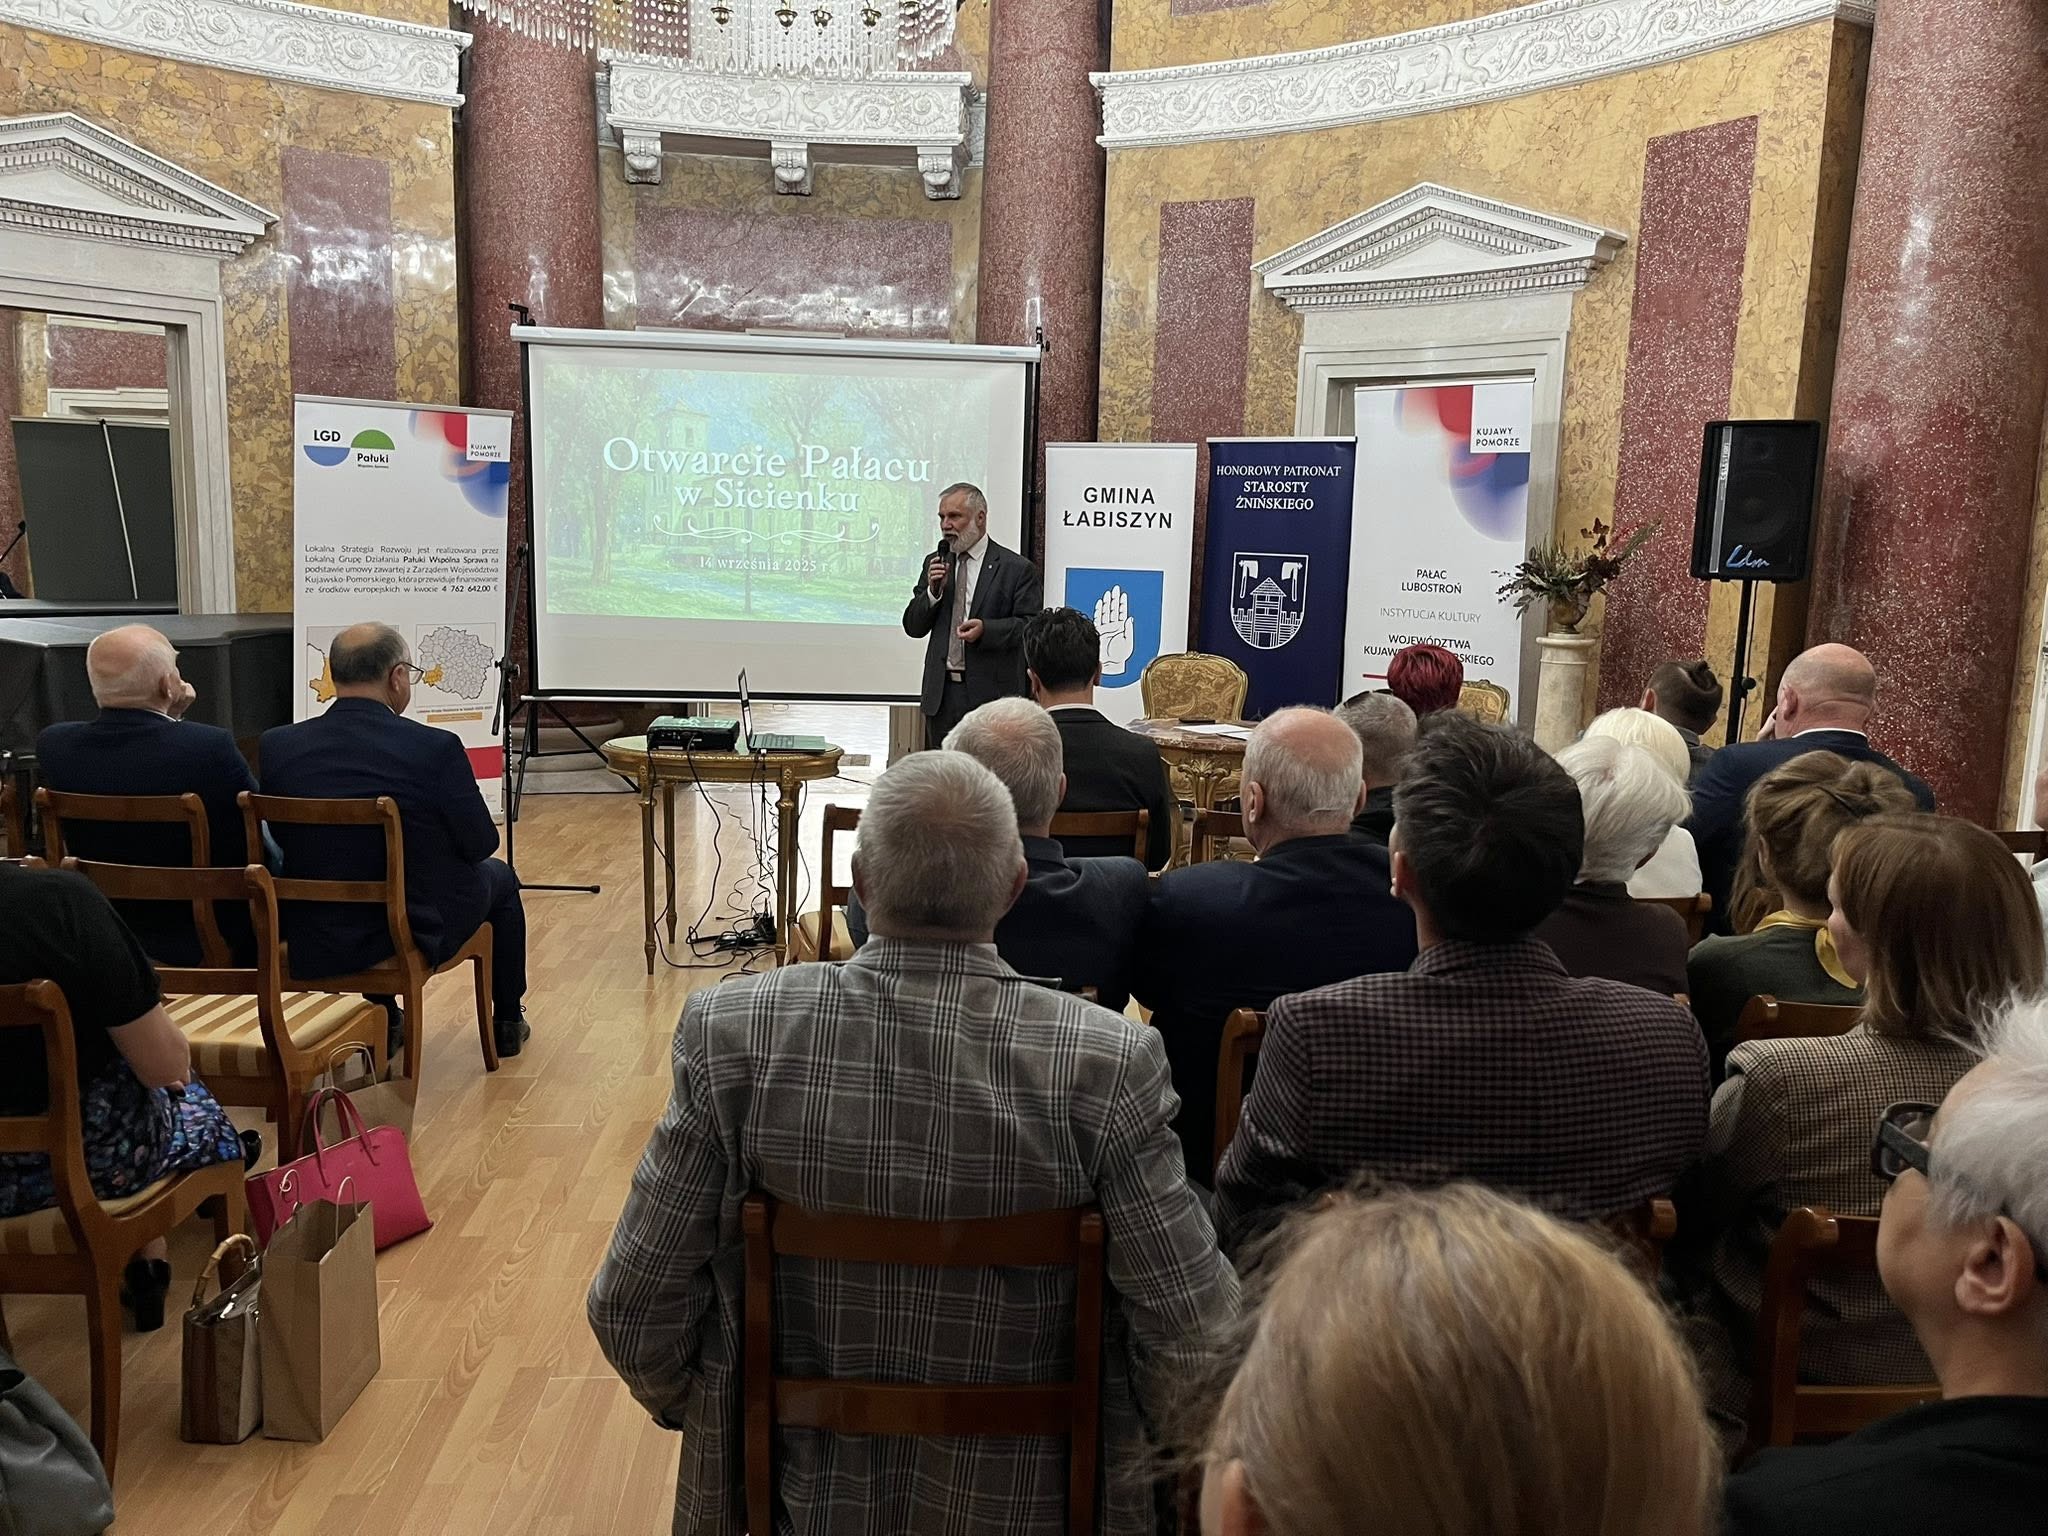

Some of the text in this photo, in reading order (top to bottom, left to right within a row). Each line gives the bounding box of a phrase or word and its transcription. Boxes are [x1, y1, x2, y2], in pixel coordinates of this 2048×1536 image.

[314, 430, 341, 442] LGD
[1476, 427, 1513, 436] KUJAWY
[1475, 437, 1520, 447] POMORZE
[357, 453, 389, 463] Pałuki
[602, 437, 931, 483] Otwarcie Pałacu
[1216, 465, 1342, 477] HONOROWY PATRONAT
[1243, 481, 1310, 494] STAROSTY
[674, 479, 860, 513] w Sicienku
[1083, 487, 1155, 505] GMINA
[1235, 497, 1314, 511] ŻNIŃSKIEGO
[1063, 511, 1173, 529] ŁABISZYN
[305, 544, 335, 552] Lokalna
[341, 545, 374, 553] Strategia
[381, 546, 412, 554] Rozwoju
[429, 556, 460, 564] Wspólna
[700, 556, 712, 569] 14
[717, 556, 781, 572] września
[784, 558, 818, 573] 2025
[374, 566, 405, 574] zawartej
[1416, 569, 1447, 579] PAŁAC
[354, 586, 400, 594] europejskich
[1401, 582, 1462, 594] LUBOSTROŃ
[1380, 607, 1481, 623] INSTYTUCJA KULTURY
[1388, 634, 1471, 649] WOJEWÓDZTWA
